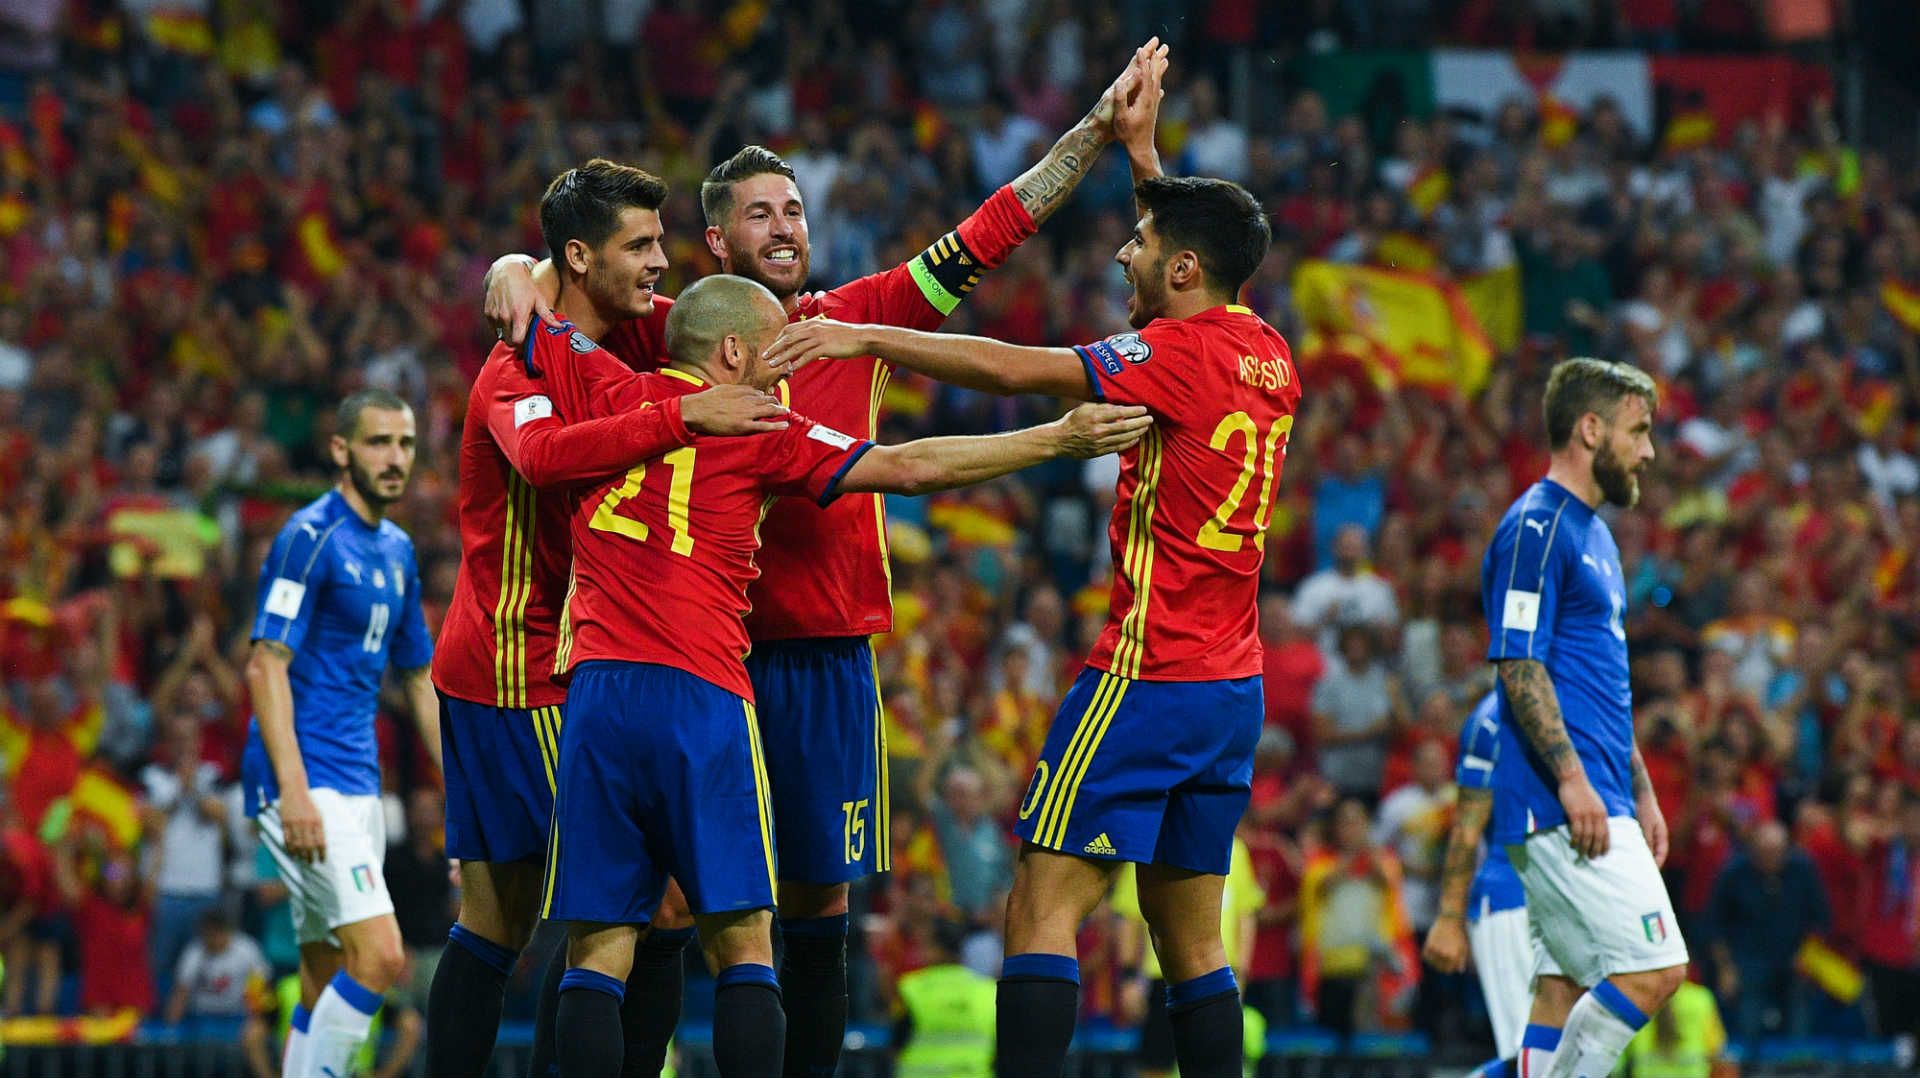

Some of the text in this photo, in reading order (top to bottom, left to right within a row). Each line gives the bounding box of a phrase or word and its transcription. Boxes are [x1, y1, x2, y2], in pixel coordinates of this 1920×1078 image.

[588, 447, 697, 557] 21
[1196, 411, 1294, 552] 20
[363, 603, 390, 654] 19
[842, 799, 868, 864] 15
[1084, 846, 1116, 855] adidas
